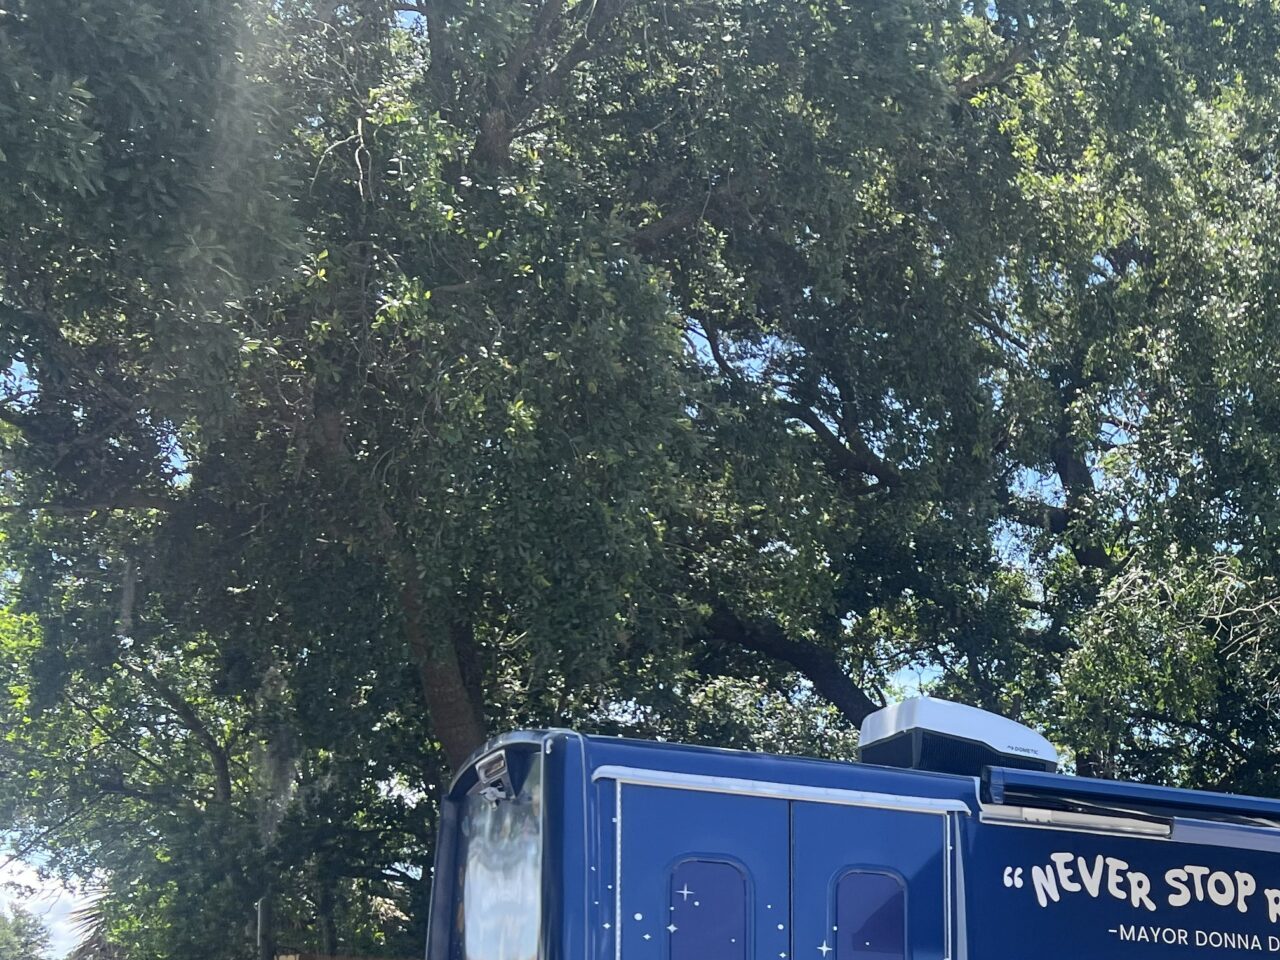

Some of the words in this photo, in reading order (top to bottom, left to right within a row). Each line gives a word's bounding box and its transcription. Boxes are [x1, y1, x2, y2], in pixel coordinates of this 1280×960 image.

[1164, 865, 1257, 913] STOP
[1108, 925, 1189, 946] -MAYOR
[1195, 930, 1262, 951] DONNA
